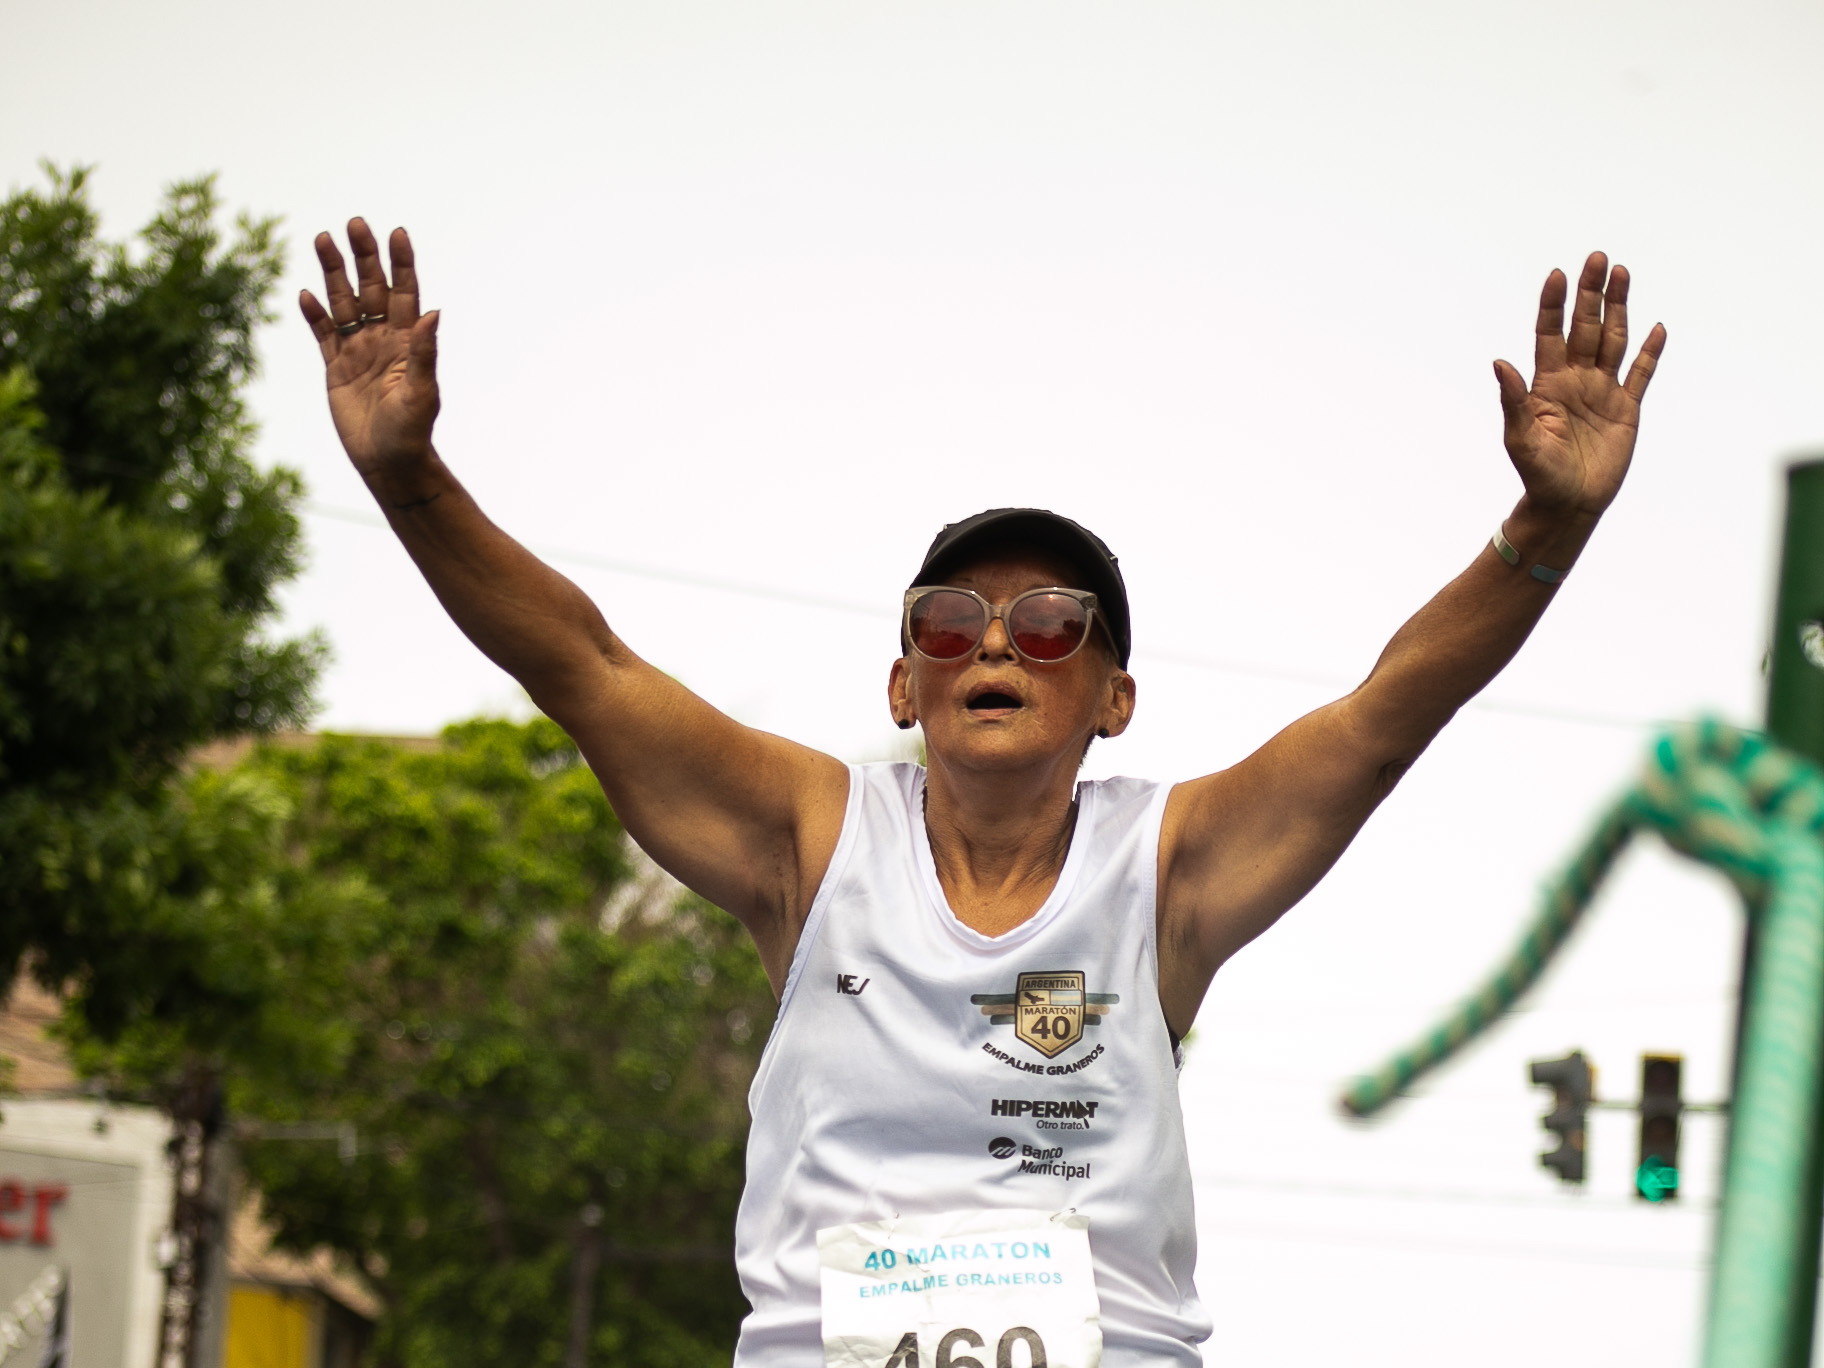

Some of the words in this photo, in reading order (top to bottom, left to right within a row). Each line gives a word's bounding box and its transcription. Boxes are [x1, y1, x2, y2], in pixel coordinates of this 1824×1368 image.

[837, 974, 870, 996] NEJ
[1024, 979, 1076, 989] ARGENTINA
[1024, 1006, 1077, 1015] MARATÓN
[1031, 1015, 1071, 1040] 40
[982, 1042, 1044, 1075] EMPALME
[1046, 1043, 1105, 1076] GRANEROS
[1036, 1119, 1058, 1130] Otro
[1022, 1144, 1063, 1160] Banco
[1017, 1160, 1091, 1181] Municipal
[864, 1249, 897, 1271] 40
[906, 1241, 1052, 1265] MARATON
[859, 1274, 949, 1298] EMPALME
[956, 1272, 1063, 1287] GRANEROS
